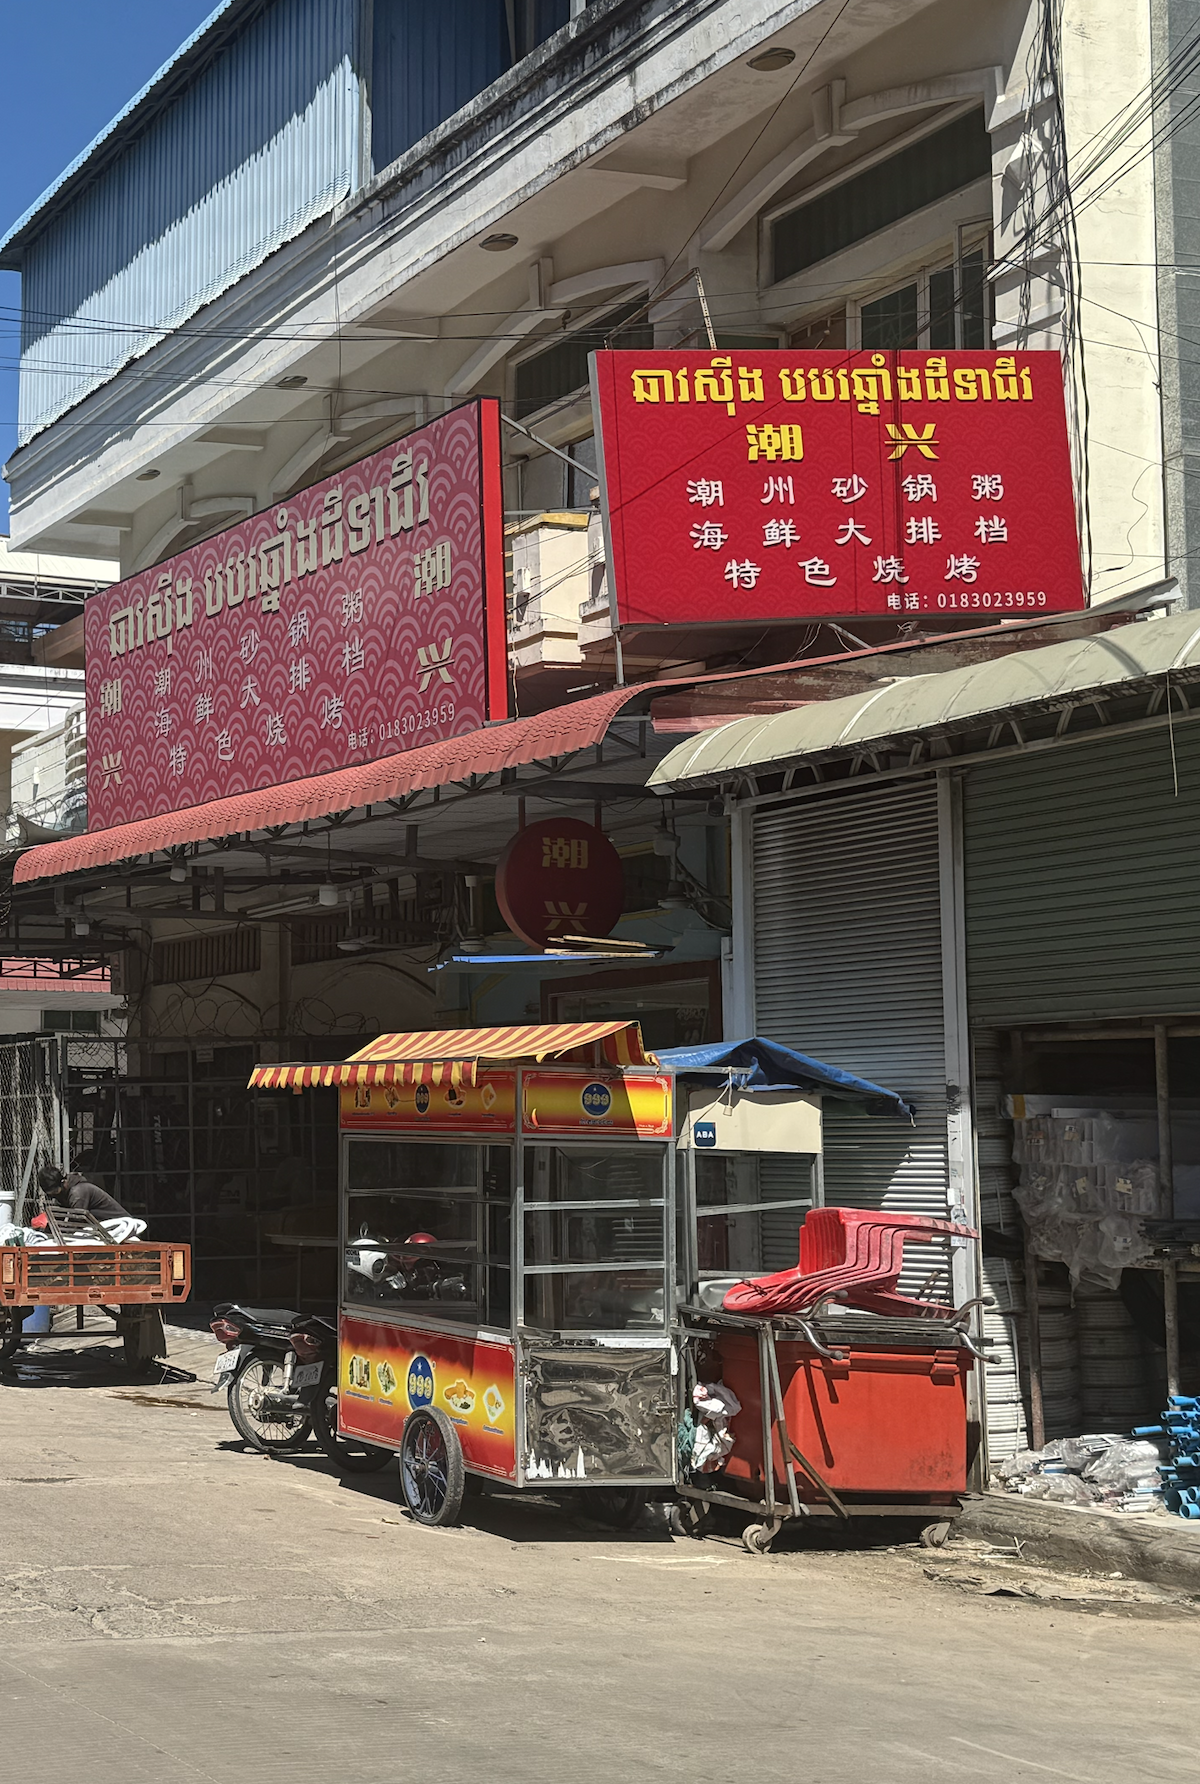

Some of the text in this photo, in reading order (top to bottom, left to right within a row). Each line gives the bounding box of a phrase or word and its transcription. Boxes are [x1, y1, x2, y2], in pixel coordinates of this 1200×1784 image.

[746, 423, 940, 461] 潮兴
[686, 474, 1004, 507] 潮州砂锅粥
[689, 515, 1009, 551] 海鲜大排档
[724, 554, 981, 588] 特色烧烤
[413, 541, 455, 693] 潮兴
[937, 591, 1047, 608] 0183023959
[154, 591, 364, 696] 潮州砂锅粥
[154, 636, 366, 739] 海鲜大排档
[170, 693, 345, 777] 特色烧烤
[379, 704, 456, 741] 0183023959
[541, 837, 590, 932] 潮兴
[696, 1131, 714, 1139] ABA
